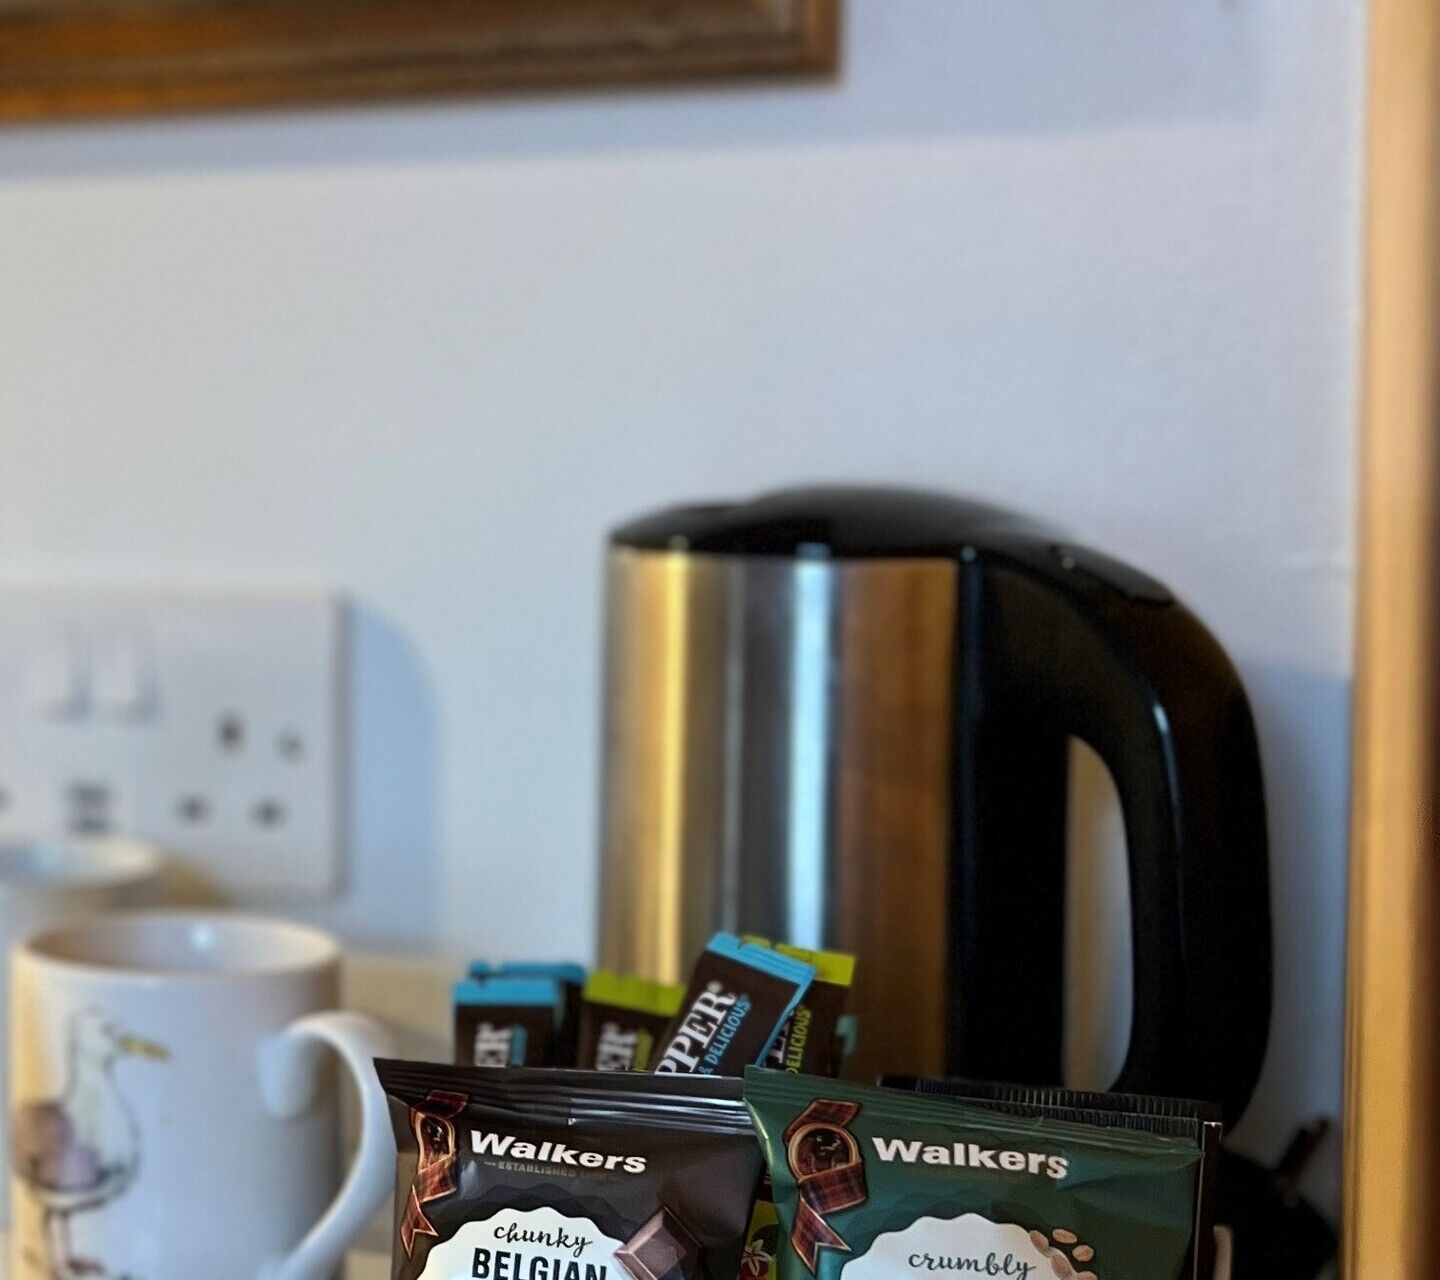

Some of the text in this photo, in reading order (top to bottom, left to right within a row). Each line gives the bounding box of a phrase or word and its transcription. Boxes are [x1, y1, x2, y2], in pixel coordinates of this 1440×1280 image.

[705, 996, 751, 1066] DELICIOUS
[470, 1129, 648, 1174] Walkers
[871, 1136, 1070, 1180] Walkers
[493, 1222, 594, 1258] chunky
